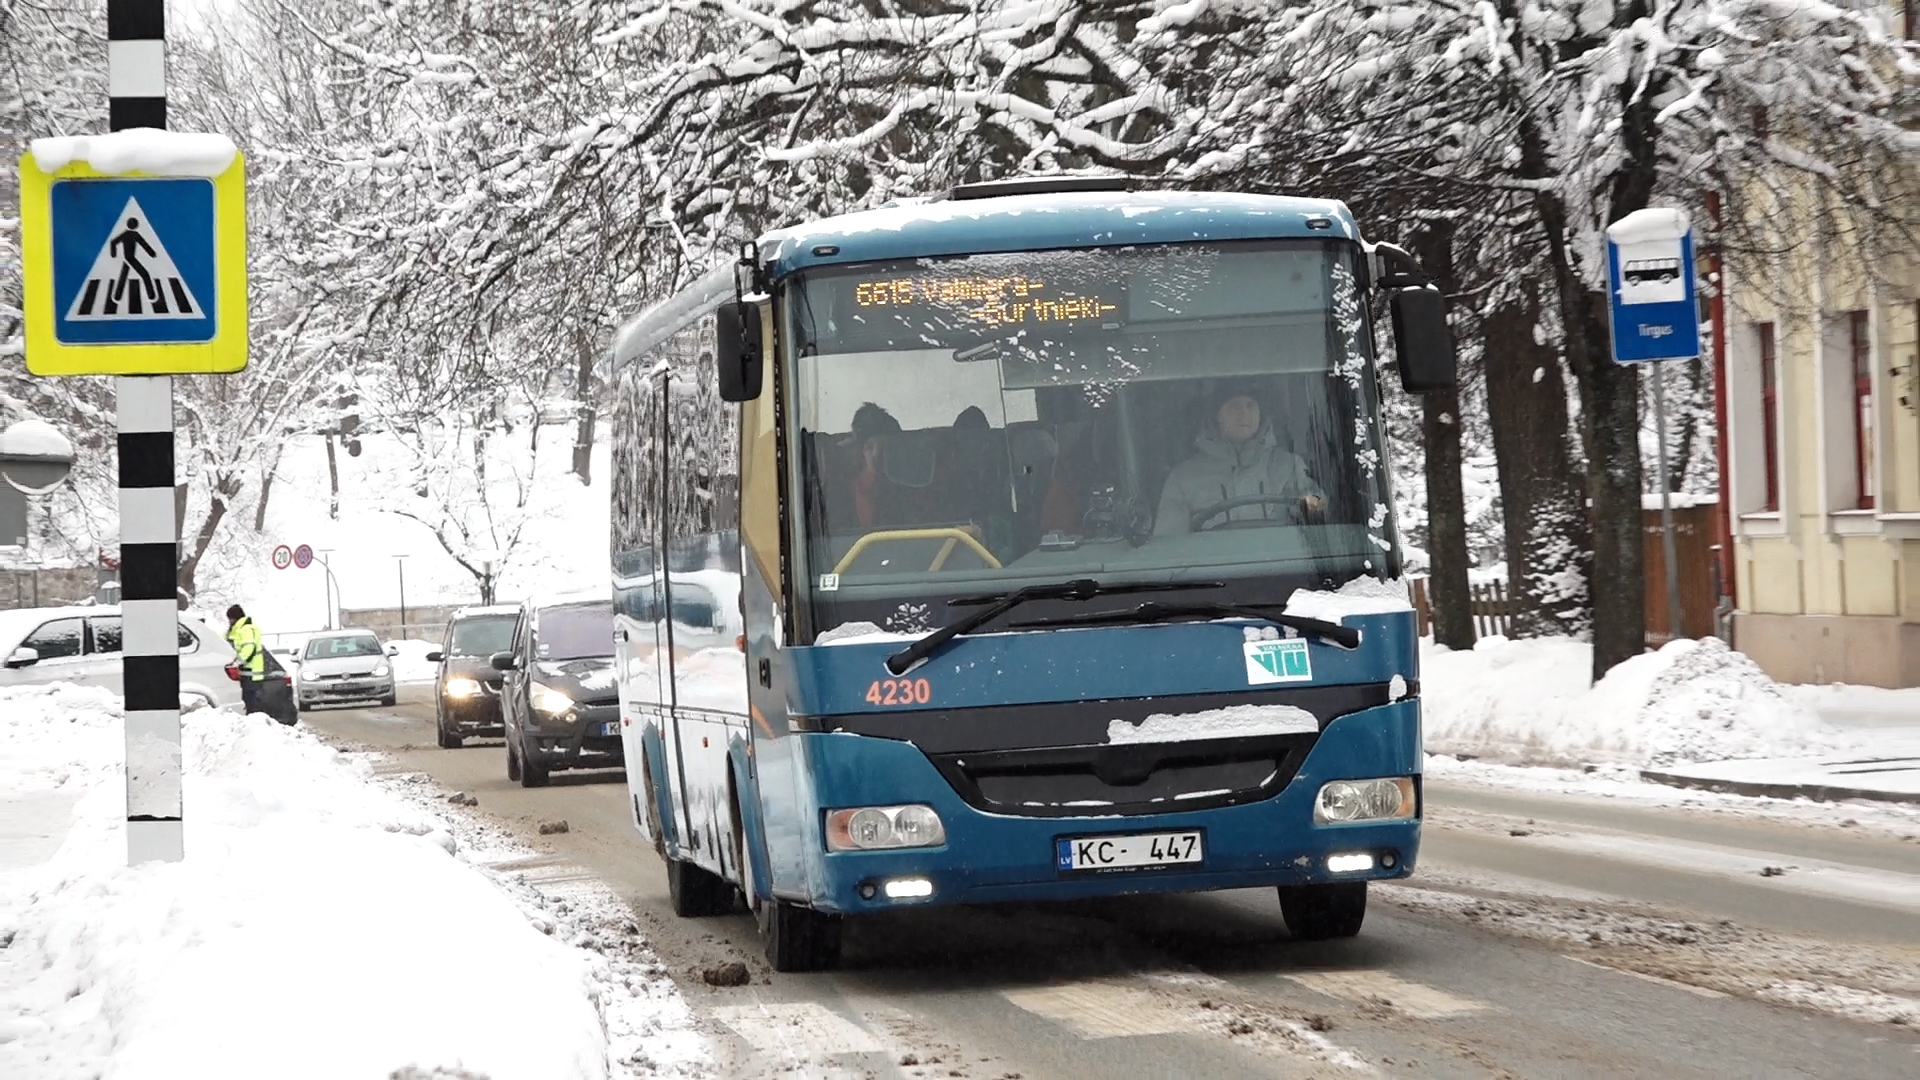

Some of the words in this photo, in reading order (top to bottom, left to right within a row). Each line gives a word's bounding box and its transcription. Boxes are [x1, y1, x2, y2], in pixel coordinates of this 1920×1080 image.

[856, 280, 913, 306] 6615
[277, 551, 288, 564] 20
[865, 678, 931, 705] 4230
[1150, 835, 1197, 860] 447
[1060, 856, 1071, 865] LV
